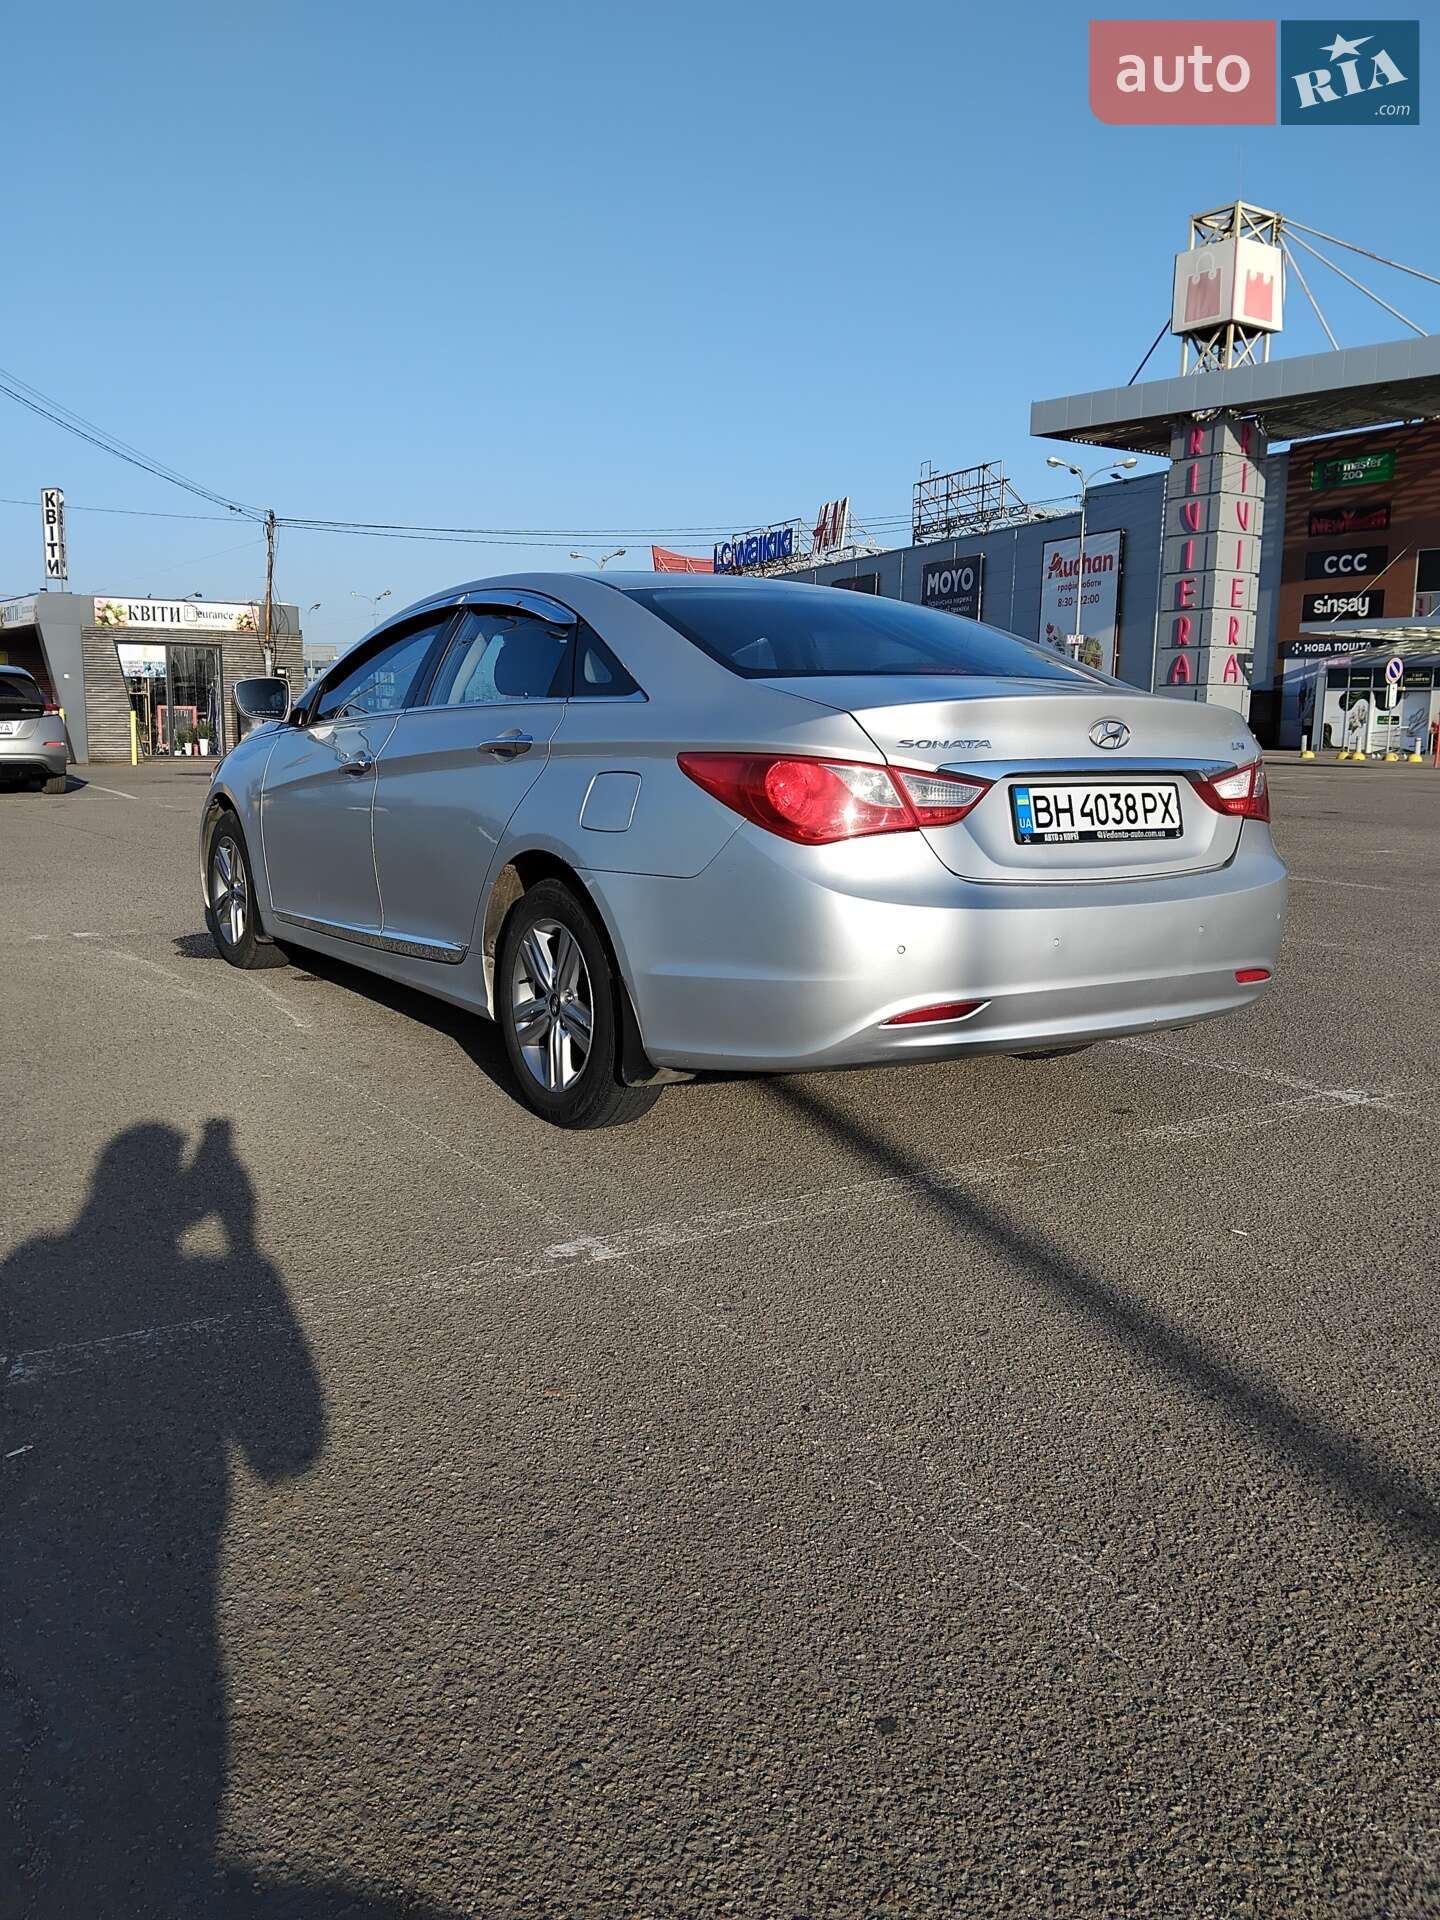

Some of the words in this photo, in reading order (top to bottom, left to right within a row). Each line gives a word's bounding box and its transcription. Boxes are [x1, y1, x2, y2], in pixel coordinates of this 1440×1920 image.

[44, 492, 60, 575] КВІТИ
[713, 543, 733, 574] LC
[1171, 424, 1205, 684] RIVIERA
[1223, 422, 1250, 683] RIVIERA
[1324, 553, 1368, 573] CCC
[1048, 553, 1114, 579] Auchan
[926, 567, 974, 596] MOYO
[128, 605, 181, 622] КВІТИ
[1057, 596, 1073, 607] 8:30
[1313, 595, 1370, 617] sinsay
[1304, 643, 1332, 652] НОВА
[1334, 642, 1372, 652] ПОШТА
[896, 739, 992, 749] SONATA
[1032, 794, 1075, 829] BH
[1080, 793, 1138, 826] 4038
[1141, 792, 1175, 825] PX
[1019, 817, 1033, 829] UA
